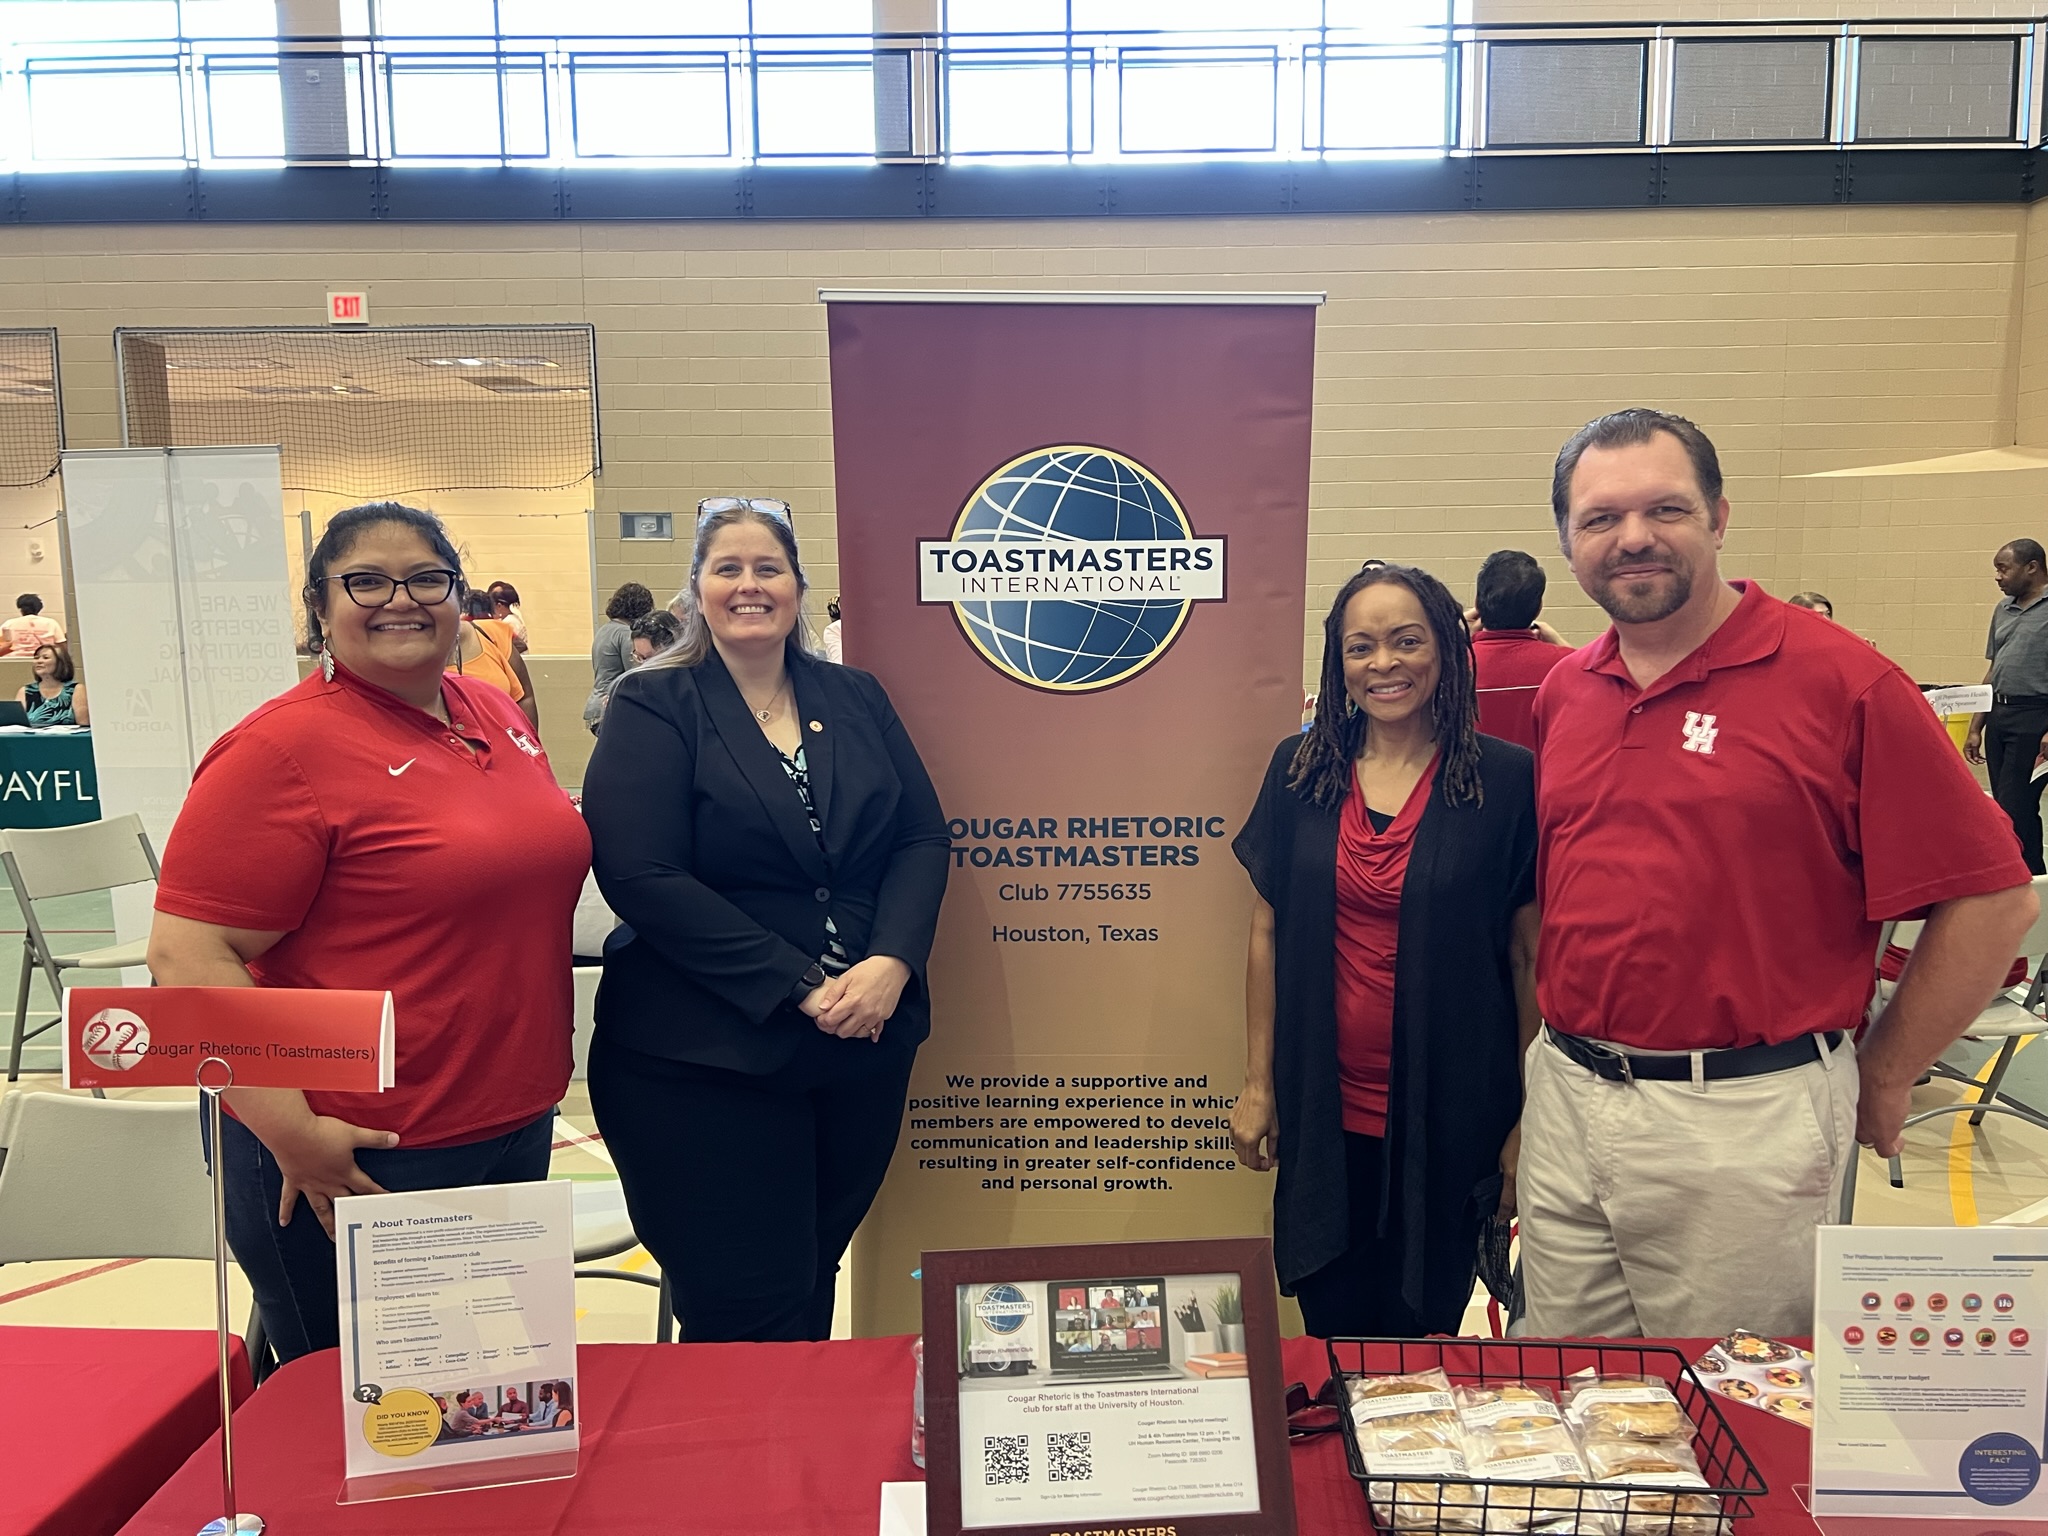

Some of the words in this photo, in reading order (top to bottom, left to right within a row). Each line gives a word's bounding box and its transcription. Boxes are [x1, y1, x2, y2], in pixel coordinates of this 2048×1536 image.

[334, 296, 360, 318] EXIT
[929, 547, 1213, 573] TOASTMASTERS
[961, 575, 1181, 593] INTERNATIONAL
[1682, 711, 1719, 754] UH
[0, 770, 94, 801] AYFL
[947, 818, 1058, 839] OUGAR
[1067, 816, 1226, 838] RHETORIC
[950, 845, 1200, 868] TOASTMASTERS
[999, 883, 1049, 901] Club
[1057, 883, 1151, 900] 7755635
[992, 925, 1090, 944] Houston,
[1098, 925, 1159, 942] Texas
[87, 1021, 138, 1055] 22
[135, 1042, 194, 1059] Cougar
[199, 1041, 261, 1056] Rhetoric
[266, 1043, 376, 1064] (Toastmasters)
[945, 1074, 975, 1088] We
[981, 1073, 1050, 1091] provide
[1055, 1077, 1065, 1088] a
[1071, 1074, 1168, 1091] supportive
[1174, 1074, 1208, 1088] and
[908, 1095, 980, 1112] positive
[986, 1095, 1059, 1111] learning
[1065, 1095, 1164, 1111] experience
[1170, 1095, 1186, 1109] in
[910, 1115, 994, 1130] members
[1000, 1118, 1028, 1130] are
[1033, 1115, 1140, 1132] empowered
[1146, 1117, 1165, 1130] to
[1170, 1115, 1231, 1130] develo
[910, 1135, 1049, 1150] communication
[1054, 1136, 1088, 1150] and
[1094, 1135, 1188, 1152] leadership
[919, 1156, 997, 1172] resulting
[1003, 1156, 1019, 1170] in
[1025, 1157, 1091, 1172] greater
[1096, 1155, 1236, 1171] self-confidence
[981, 1176, 1015, 1190] and
[1020, 1176, 1098, 1192] personal
[1104, 1176, 1173, 1192] growth.
[372, 1219, 404, 1229] About
[406, 1214, 473, 1226] Toastmasters
[373, 1258, 397, 1266] Benefits
[431, 1252, 468, 1261] Toastmasters
[374, 1293, 405, 1302] Employees
[977, 1303, 1031, 1311] TOASTMASTERS
[403, 1334, 442, 1343] Toastmasters?
[1908, 1374, 1930, 1382] budget
[1007, 1395, 1036, 1404] Cougar
[1038, 1393, 1071, 1402] Rhetoric
[1073, 1392, 1080, 1400] is
[1096, 1389, 1149, 1399] Toastmasters
[1150, 1386, 1199, 1397] International
[1023, 1404, 1040, 1413] club
[1042, 1403, 1053, 1412] for
[1055, 1403, 1073, 1411] staff
[1074, 1403, 1082, 1411] at
[1084, 1402, 1096, 1410] the
[1098, 1400, 1138, 1411] University
[1139, 1400, 1148, 1408] of
[1149, 1398, 1185, 1407] Houston.
[1380, 1450, 1433, 1458] TOASTMASTERS
